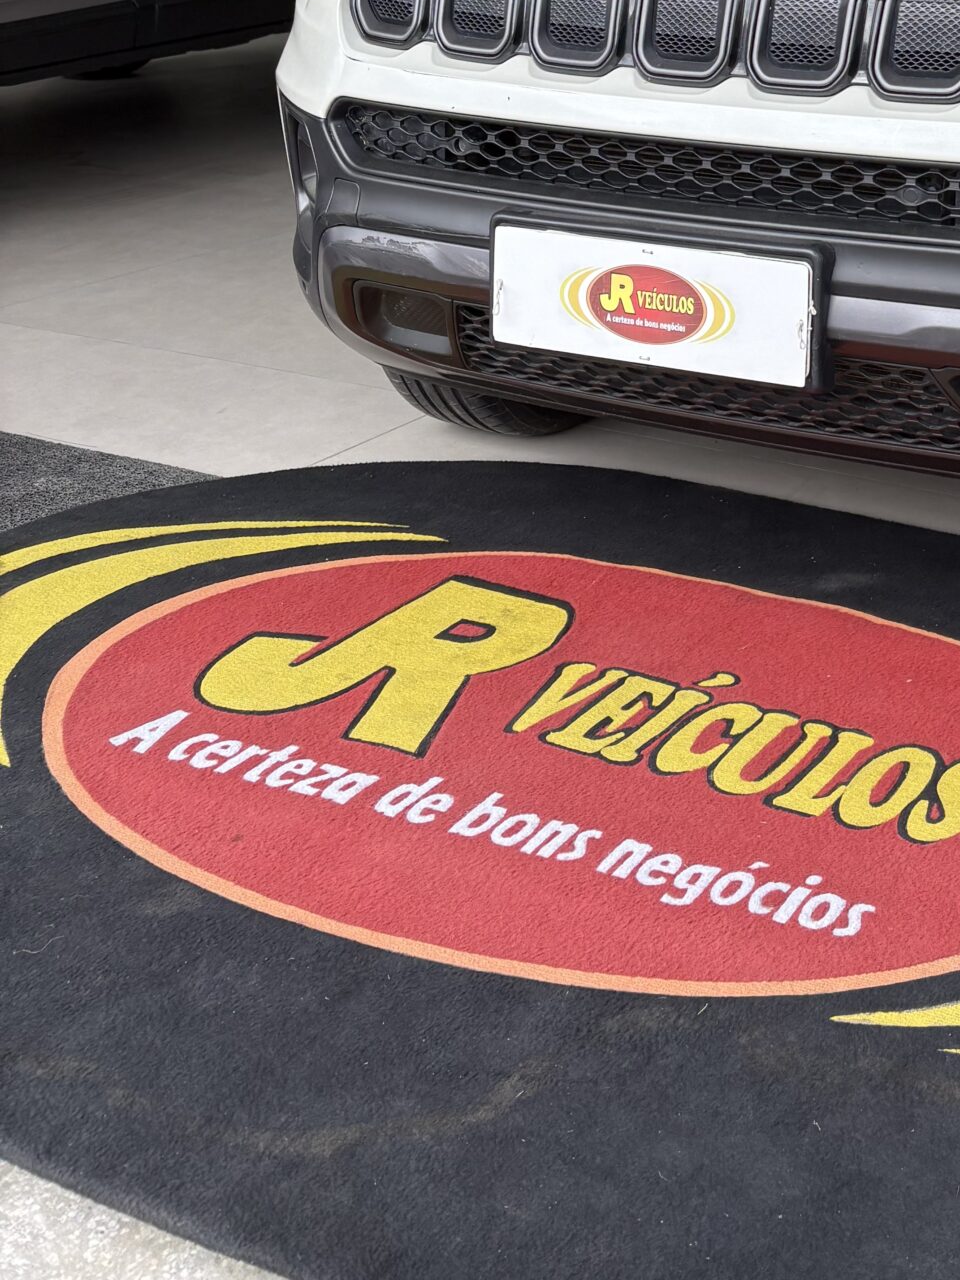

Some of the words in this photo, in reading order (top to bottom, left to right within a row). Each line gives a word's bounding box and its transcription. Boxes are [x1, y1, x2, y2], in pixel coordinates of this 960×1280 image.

[599, 272, 636, 314] JR
[636, 287, 695, 315] VEÍCULOS
[606, 313, 612, 323] A
[612, 315, 635, 325] certeza
[635, 317, 643, 326] de
[644, 318, 659, 329] bons
[659, 321, 686, 333] negócios
[193, 574, 574, 758] JR
[108, 709, 191, 754] A
[167, 733, 381, 805] certeza
[374, 776, 454, 825] de
[449, 791, 602, 862] bons
[597, 836, 876, 937] negócios
